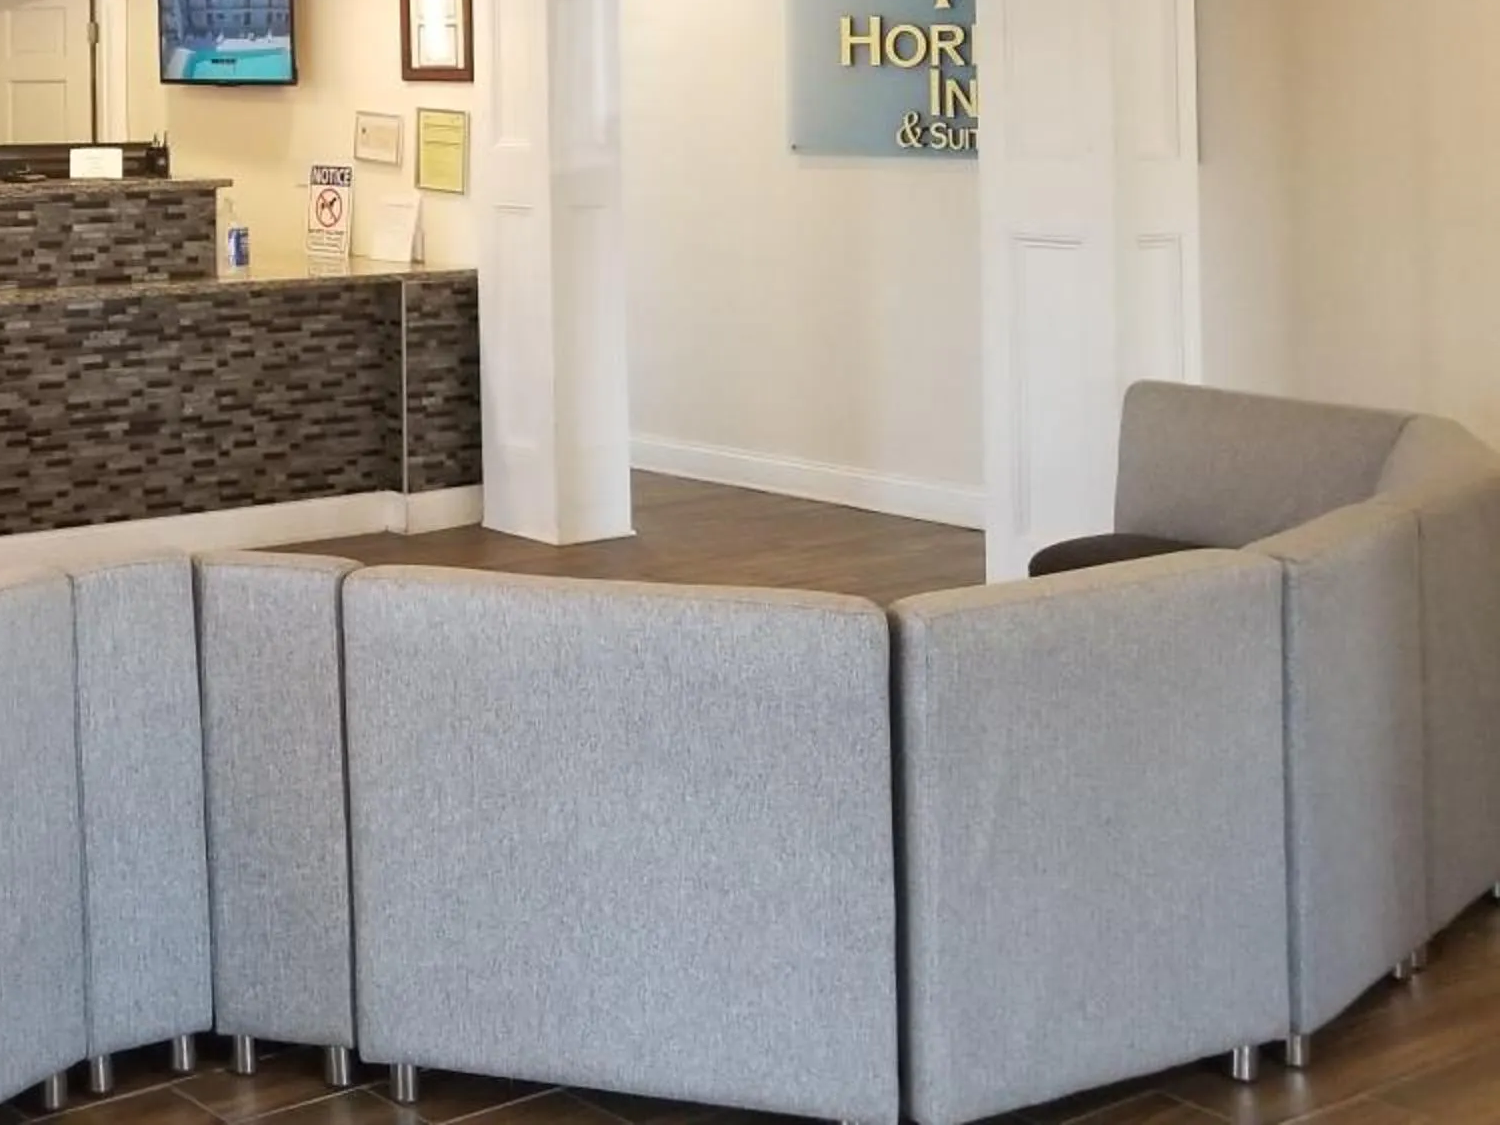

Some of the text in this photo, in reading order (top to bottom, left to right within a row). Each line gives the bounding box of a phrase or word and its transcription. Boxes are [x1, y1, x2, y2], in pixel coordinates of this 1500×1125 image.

[839, 15, 977, 68] HOR
[930, 68, 978, 117] IN
[896, 111, 979, 150] & SUIT
[312, 168, 351, 186] NOTICE
